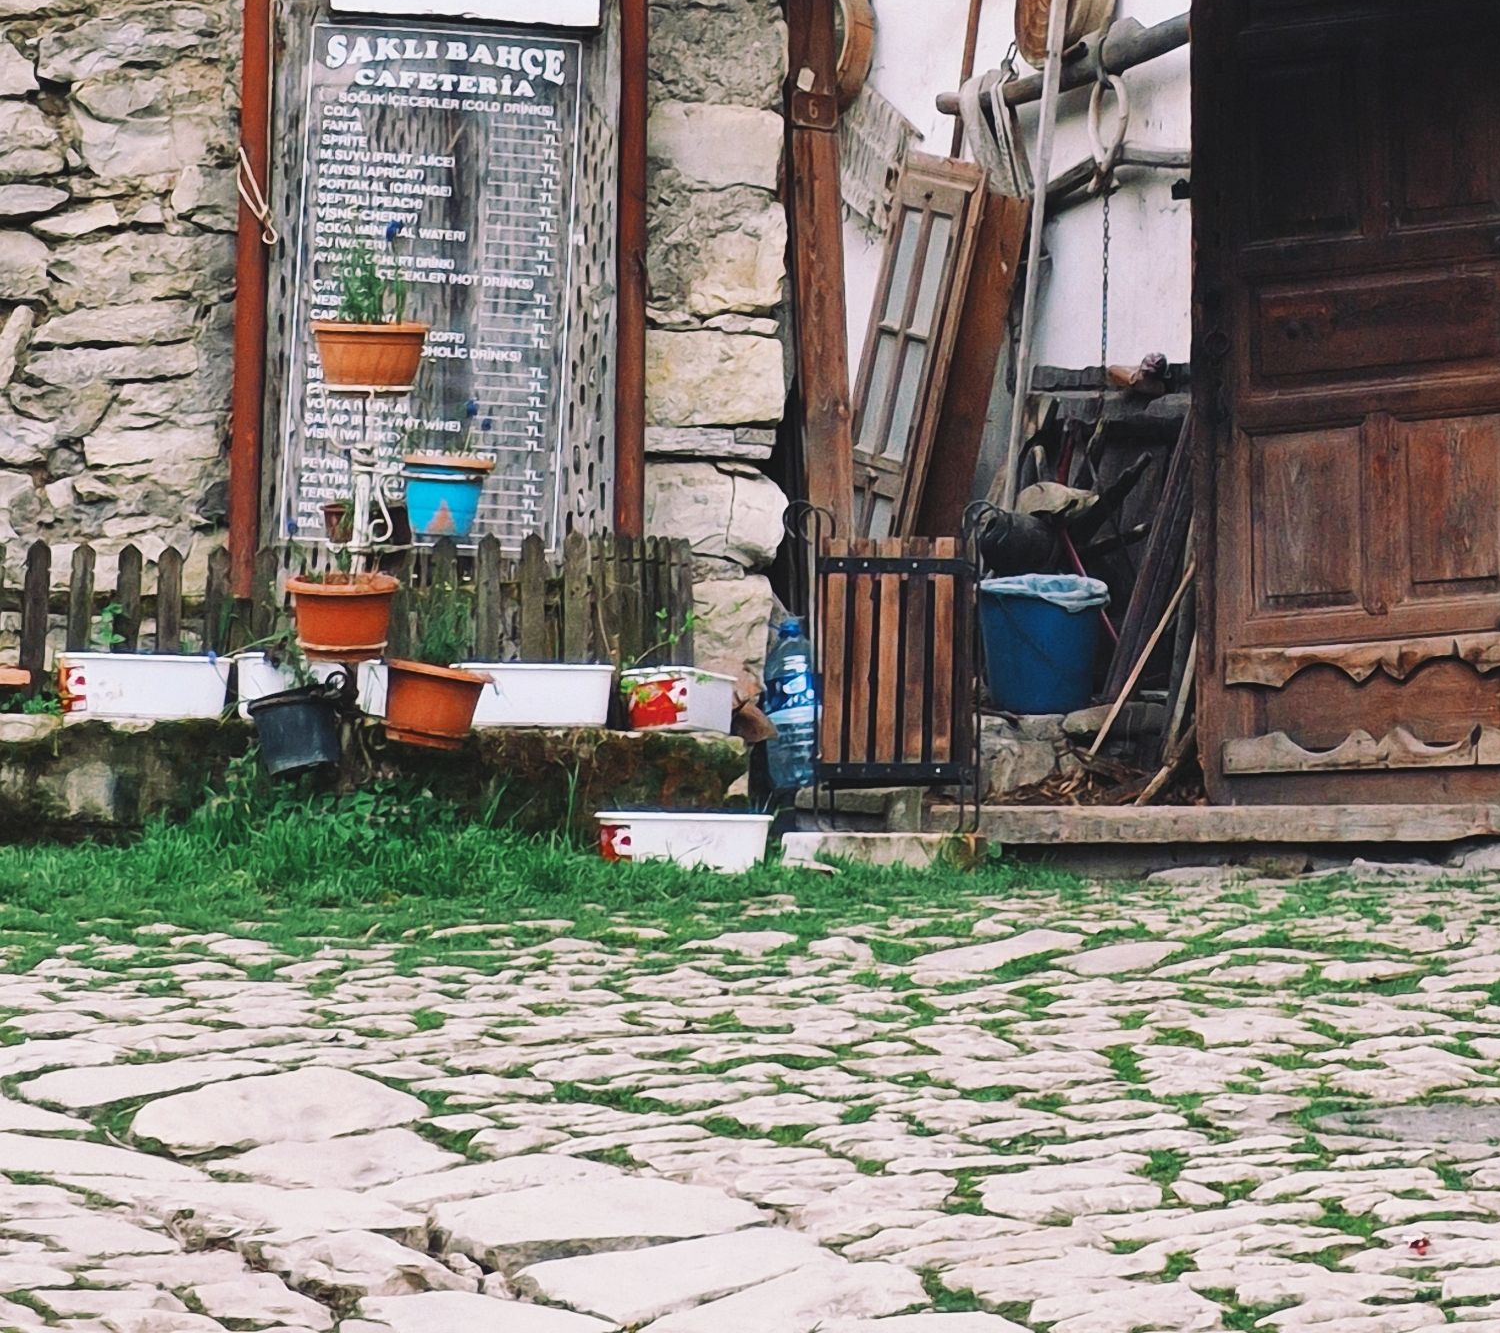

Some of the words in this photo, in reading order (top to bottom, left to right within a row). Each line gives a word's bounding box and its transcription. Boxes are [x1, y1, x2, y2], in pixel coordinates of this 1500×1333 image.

[325, 35, 439, 69] SAKLI
[445, 41, 566, 86] BAHÇE
[354, 69, 535, 97] CAFETERİA
[323, 105, 361, 118] COLA
[339, 91, 386, 106] SOĞUK
[388, 92, 458, 109] İÇECEKLER
[462, 99, 500, 113] (COLD
[808, 99, 818, 119] 6
[322, 120, 362, 132] FANTA
[318, 177, 387, 193] PORTAKAL
[389, 182, 453, 198] (ORANGE)
[372, 195, 423, 210] (PEACH)
[315, 236, 333, 248] SU
